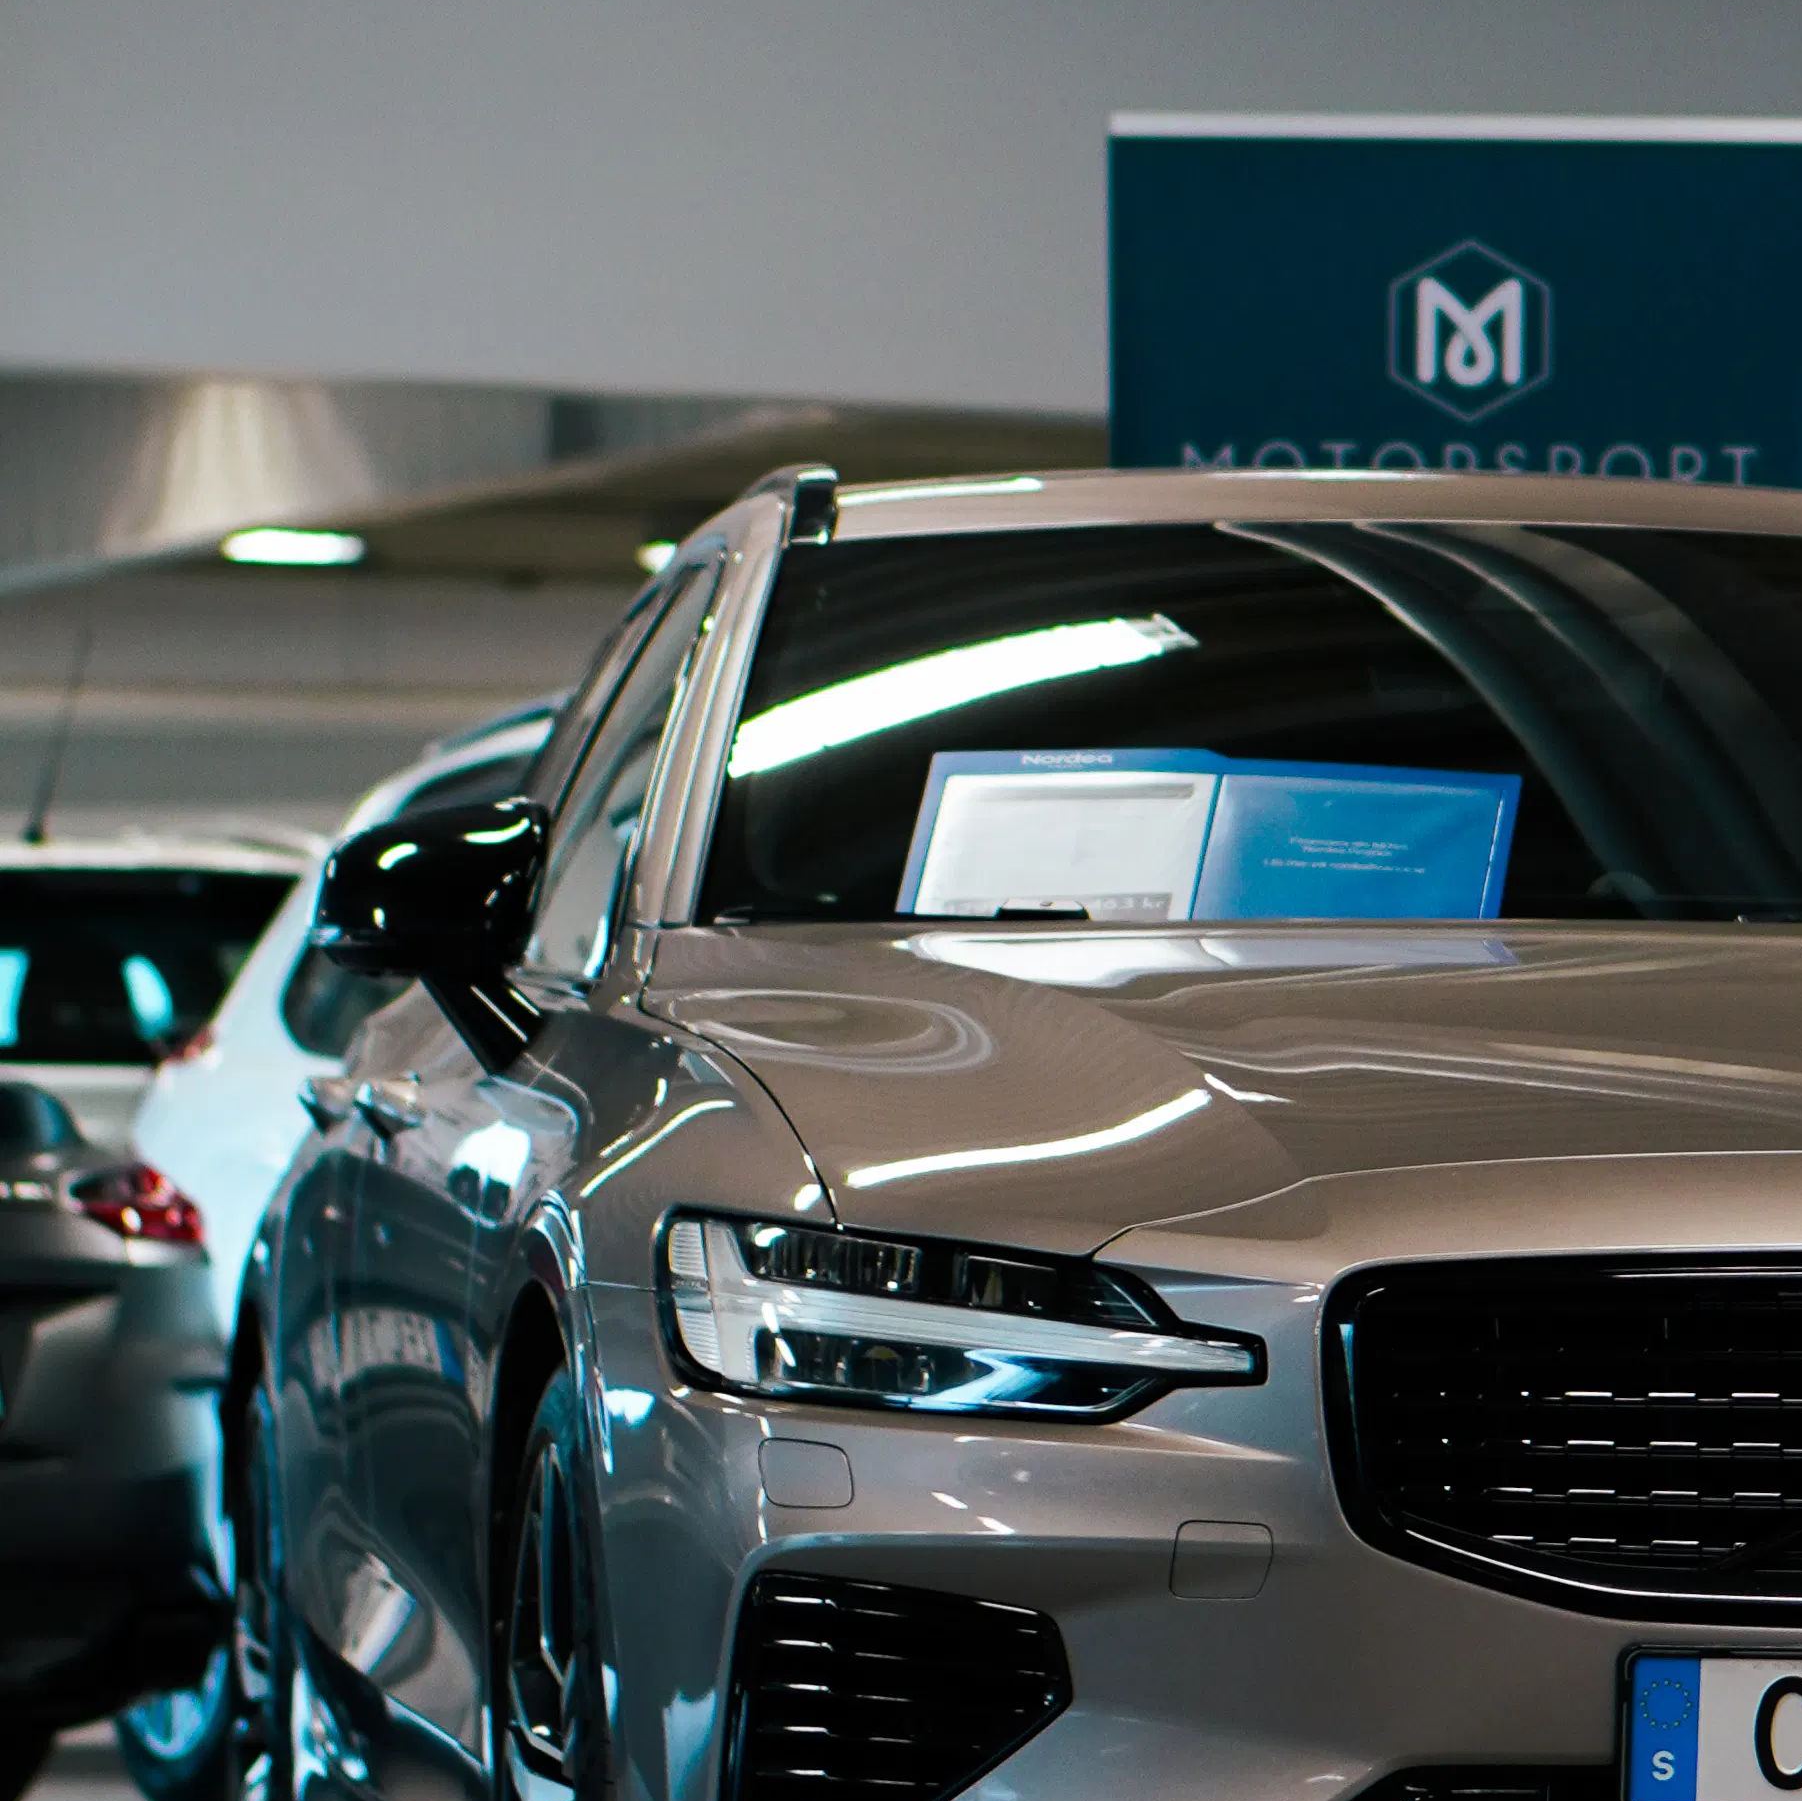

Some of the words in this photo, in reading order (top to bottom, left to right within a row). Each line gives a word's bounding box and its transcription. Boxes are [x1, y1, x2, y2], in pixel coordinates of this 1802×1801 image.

[1416, 276, 1523, 388] M
[1021, 753, 1112, 766] Nordea
[1652, 1750, 1675, 1781] S
